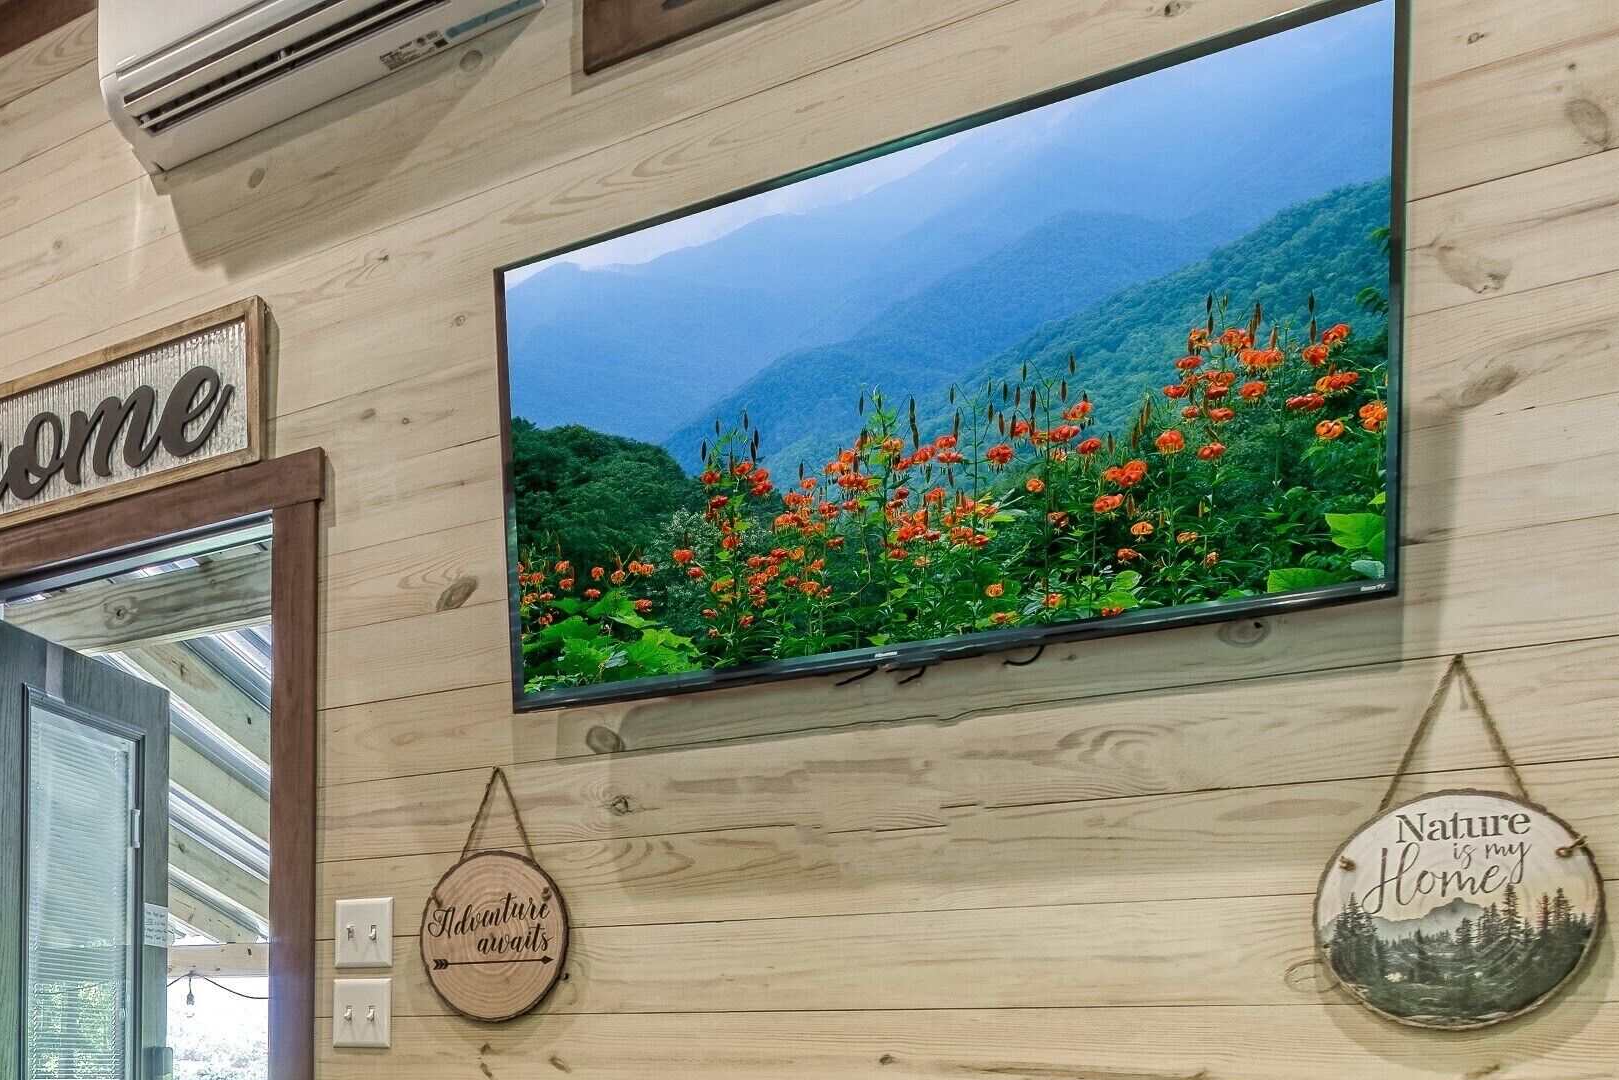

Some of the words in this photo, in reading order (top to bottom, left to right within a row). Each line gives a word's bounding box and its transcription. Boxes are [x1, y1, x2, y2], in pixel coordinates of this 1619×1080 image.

[1395, 811, 1531, 843] Nature
[1361, 842, 1510, 915] Home
[1453, 842, 1476, 869] is
[1485, 840, 1532, 885] my
[427, 892, 551, 939] Adventure
[477, 922, 553, 955] awaits
